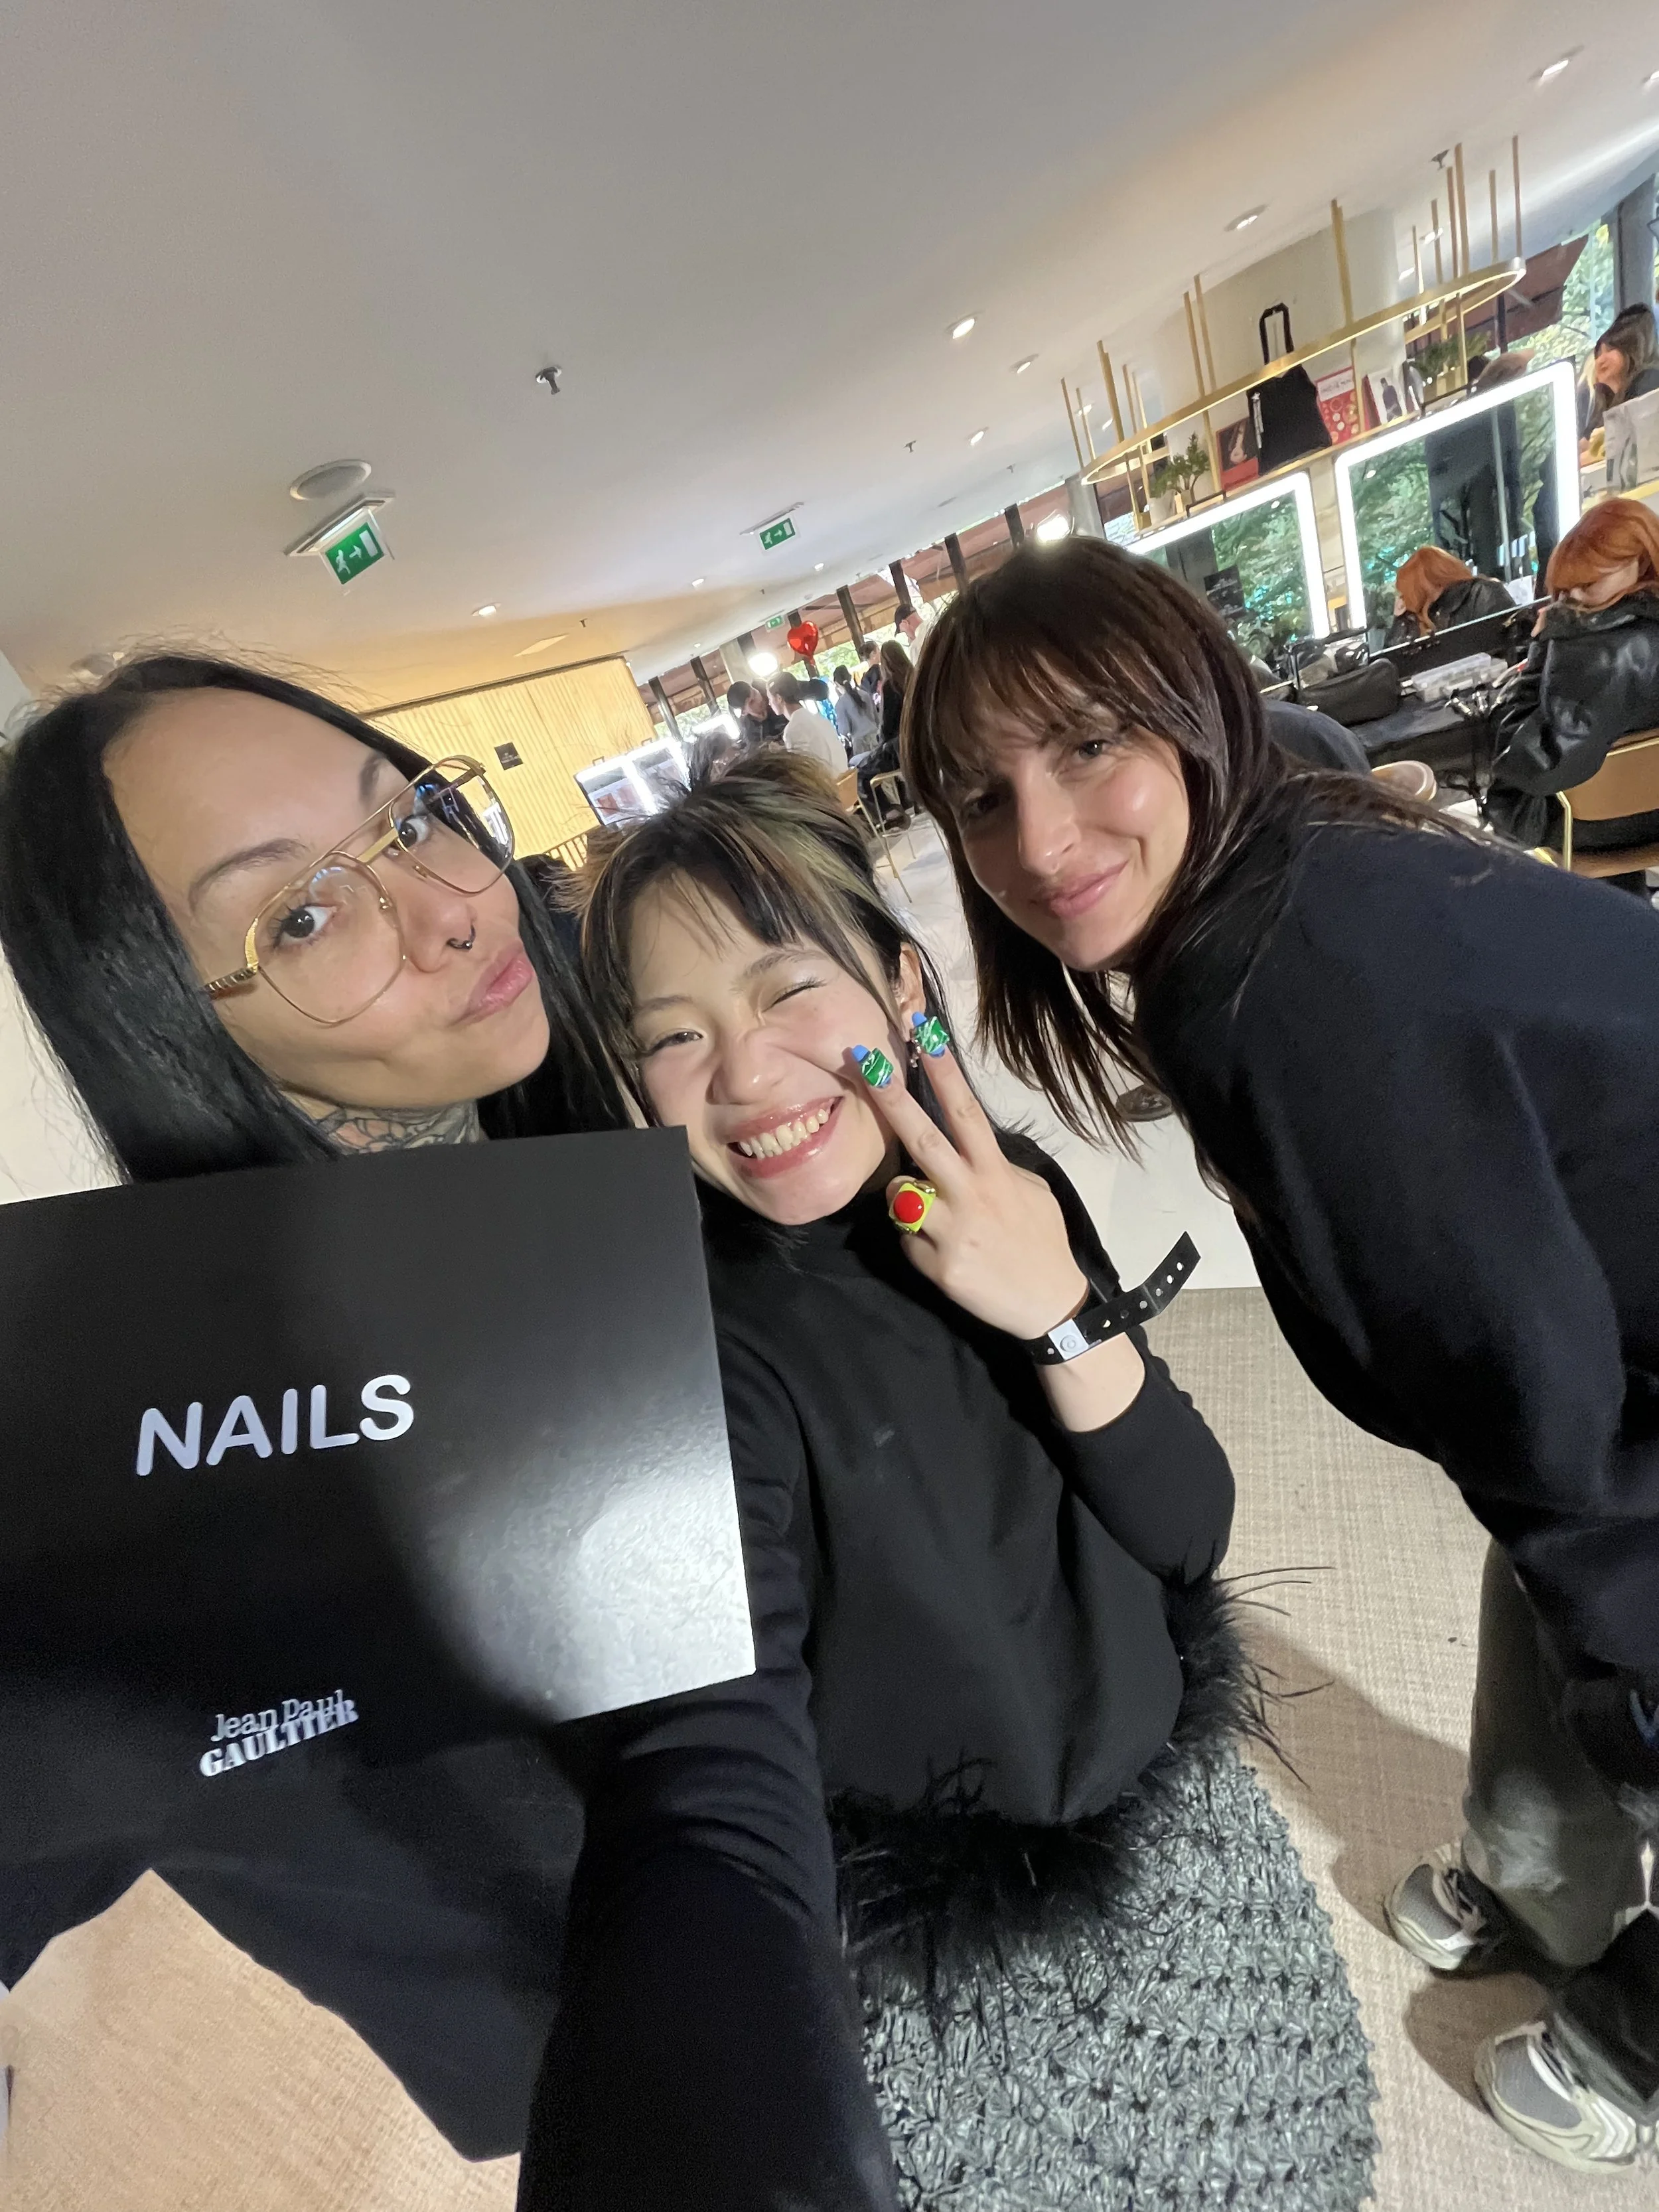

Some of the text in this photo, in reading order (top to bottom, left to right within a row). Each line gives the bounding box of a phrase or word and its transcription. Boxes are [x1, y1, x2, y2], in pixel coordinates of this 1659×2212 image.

[137, 1374, 414, 1475] NAILS
[199, 1700, 359, 1777] GAULTIER
[210, 1689, 344, 1741] Jean Paul
